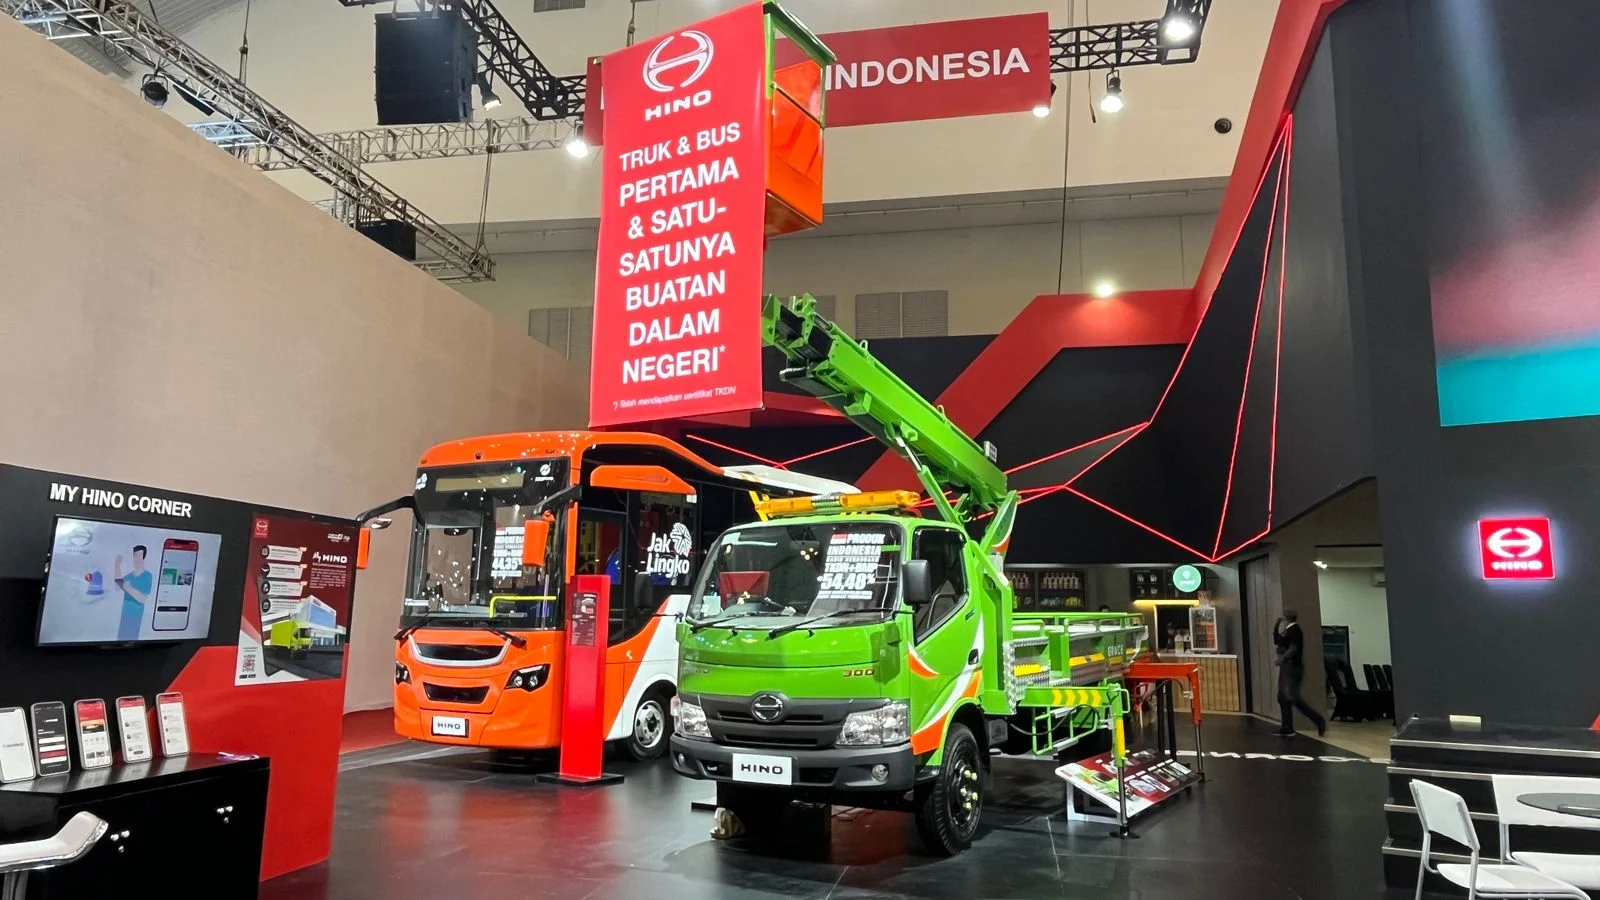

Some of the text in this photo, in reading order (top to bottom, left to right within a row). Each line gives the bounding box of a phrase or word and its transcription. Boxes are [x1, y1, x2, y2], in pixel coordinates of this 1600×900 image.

[825, 48, 1030, 91] INDONESIA
[645, 90, 711, 121] HINO
[619, 122, 741, 172] TRUK & BUS
[620, 156, 740, 207] PERTAMA
[628, 198, 727, 239] & SATU-
[619, 231, 736, 277] SATUNYA
[626, 270, 726, 311] BUATAN
[629, 308, 720, 347] DALAM
[620, 399, 636, 408] Telah
[637, 394, 682, 406] mendapatkan
[684, 389, 713, 400] sertifikat
[715, 385, 737, 396] TKDN
[50, 483, 192, 518] MY HINO CORNER
[647, 532, 671, 553] Jak
[827, 545, 881, 555] INDONESIA
[847, 534, 885, 544] PRODUK
[323, 554, 348, 564] HINO
[646, 553, 690, 578] Lingko
[1491, 560, 1543, 571] HINO
[821, 573, 876, 591] 54,48%
[843, 668, 875, 677] 300
[437, 722, 461, 730] HINO
[741, 763, 783, 775] HINO
